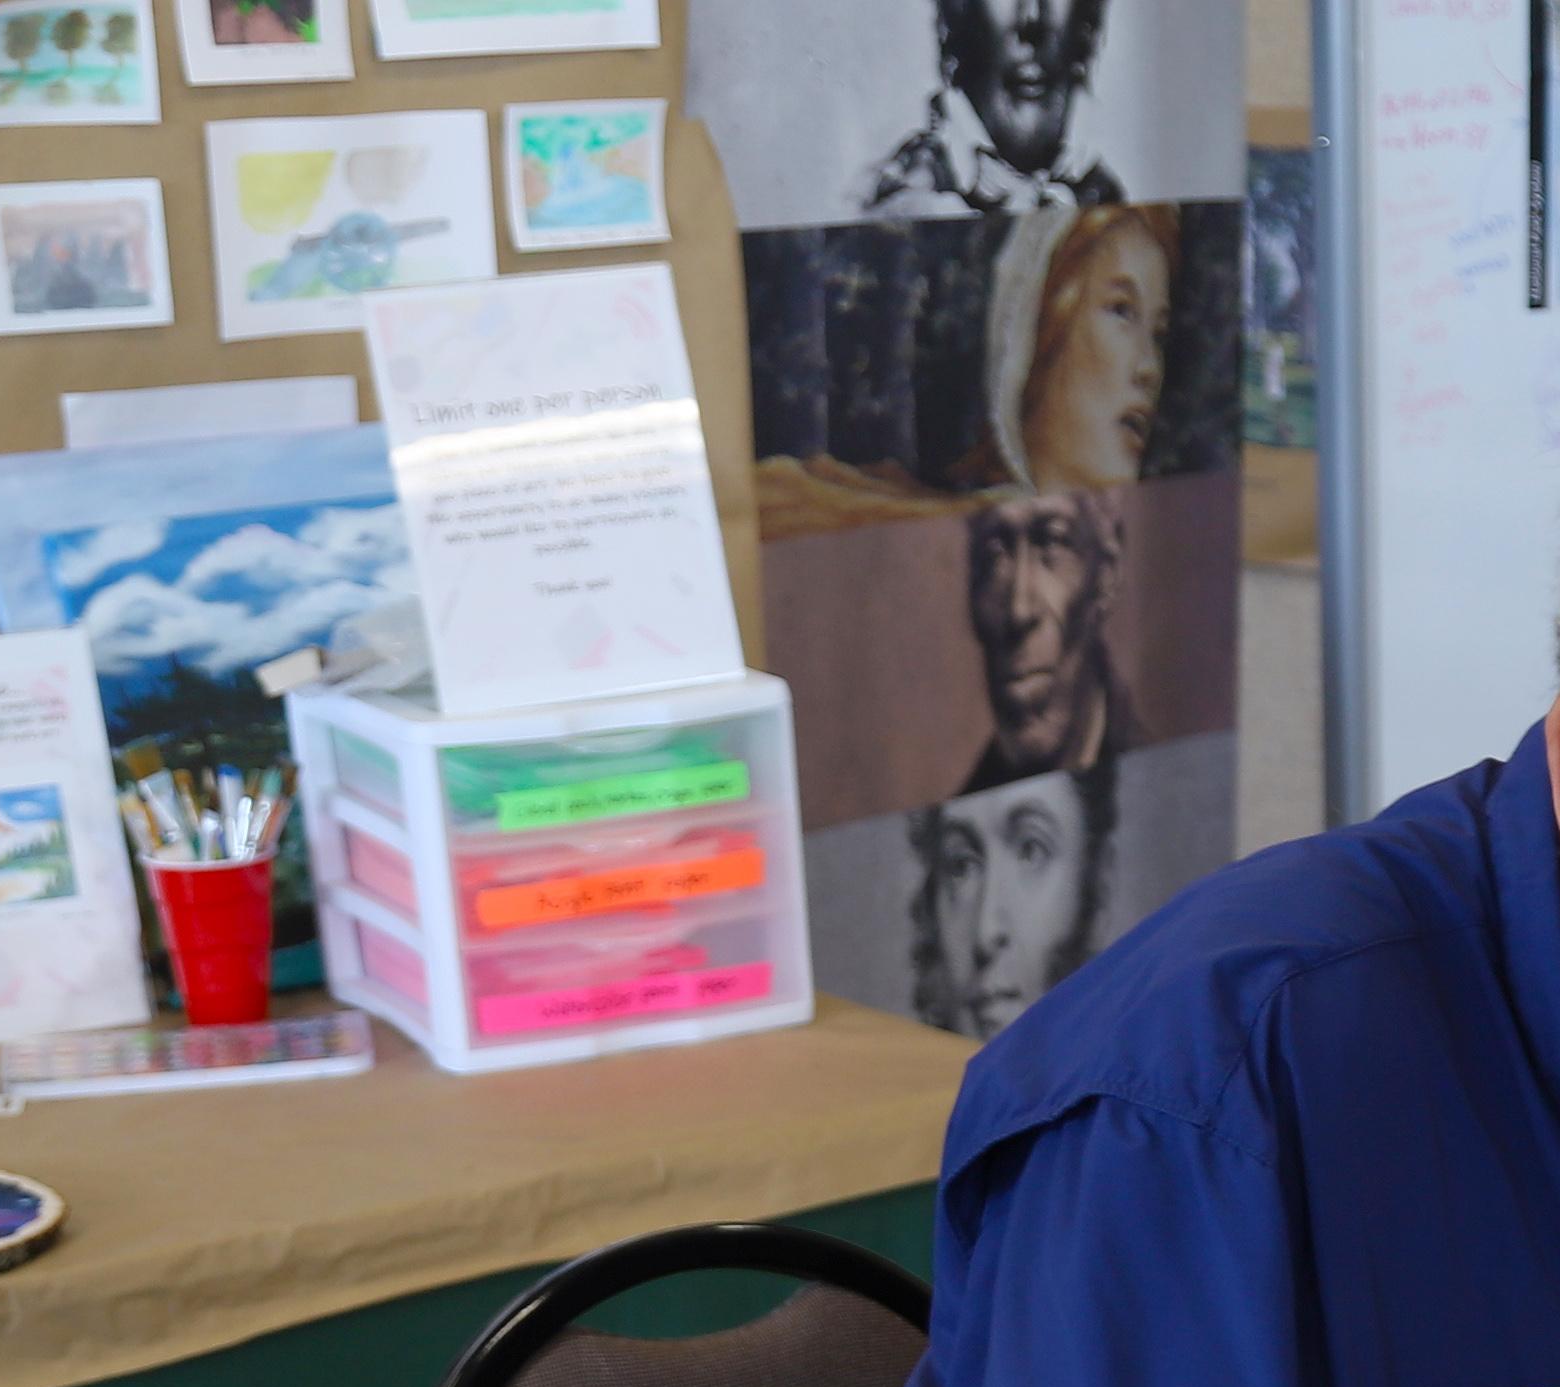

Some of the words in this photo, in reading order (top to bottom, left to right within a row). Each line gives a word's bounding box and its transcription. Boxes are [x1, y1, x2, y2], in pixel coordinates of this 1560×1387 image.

[487, 399, 526, 416] one
[533, 391, 573, 416] per
[583, 384, 664, 408] person
